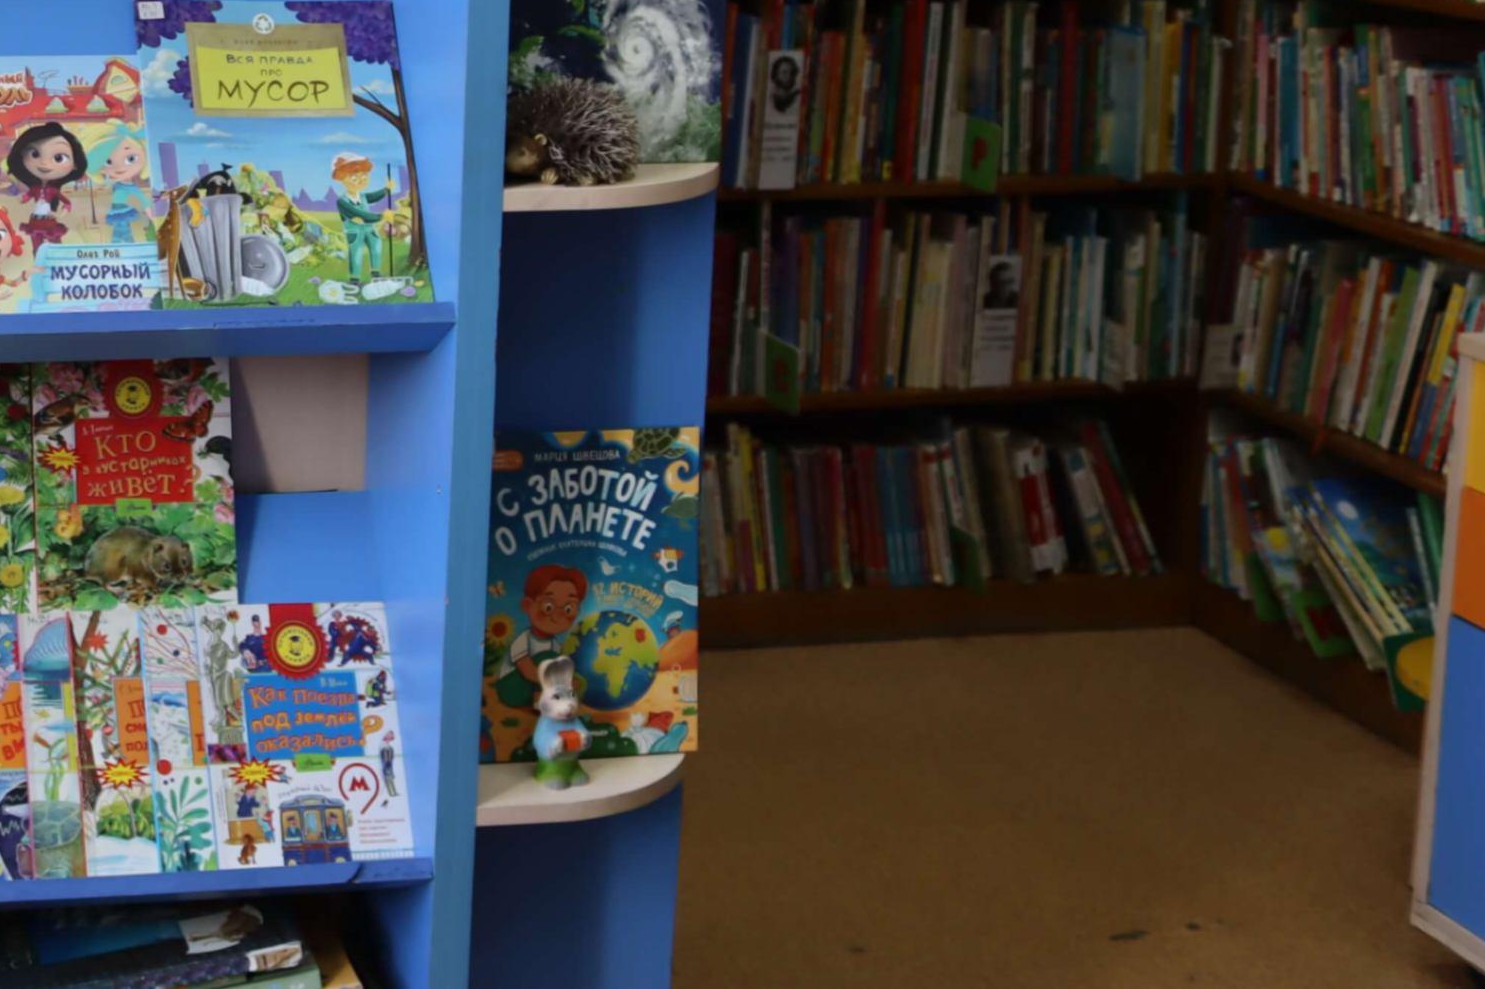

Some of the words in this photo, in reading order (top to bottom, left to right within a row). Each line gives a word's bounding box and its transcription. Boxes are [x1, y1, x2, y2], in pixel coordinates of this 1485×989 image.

[218, 79, 329, 108] МУСОР
[51, 262, 151, 280] МУСОРНЫЙ
[61, 284, 143, 300] КОЛОБОК
[95, 430, 156, 460] КТО
[528, 465, 659, 511] ЗАБОТОЙ
[523, 502, 657, 551] ПЛАНЕТЕ
